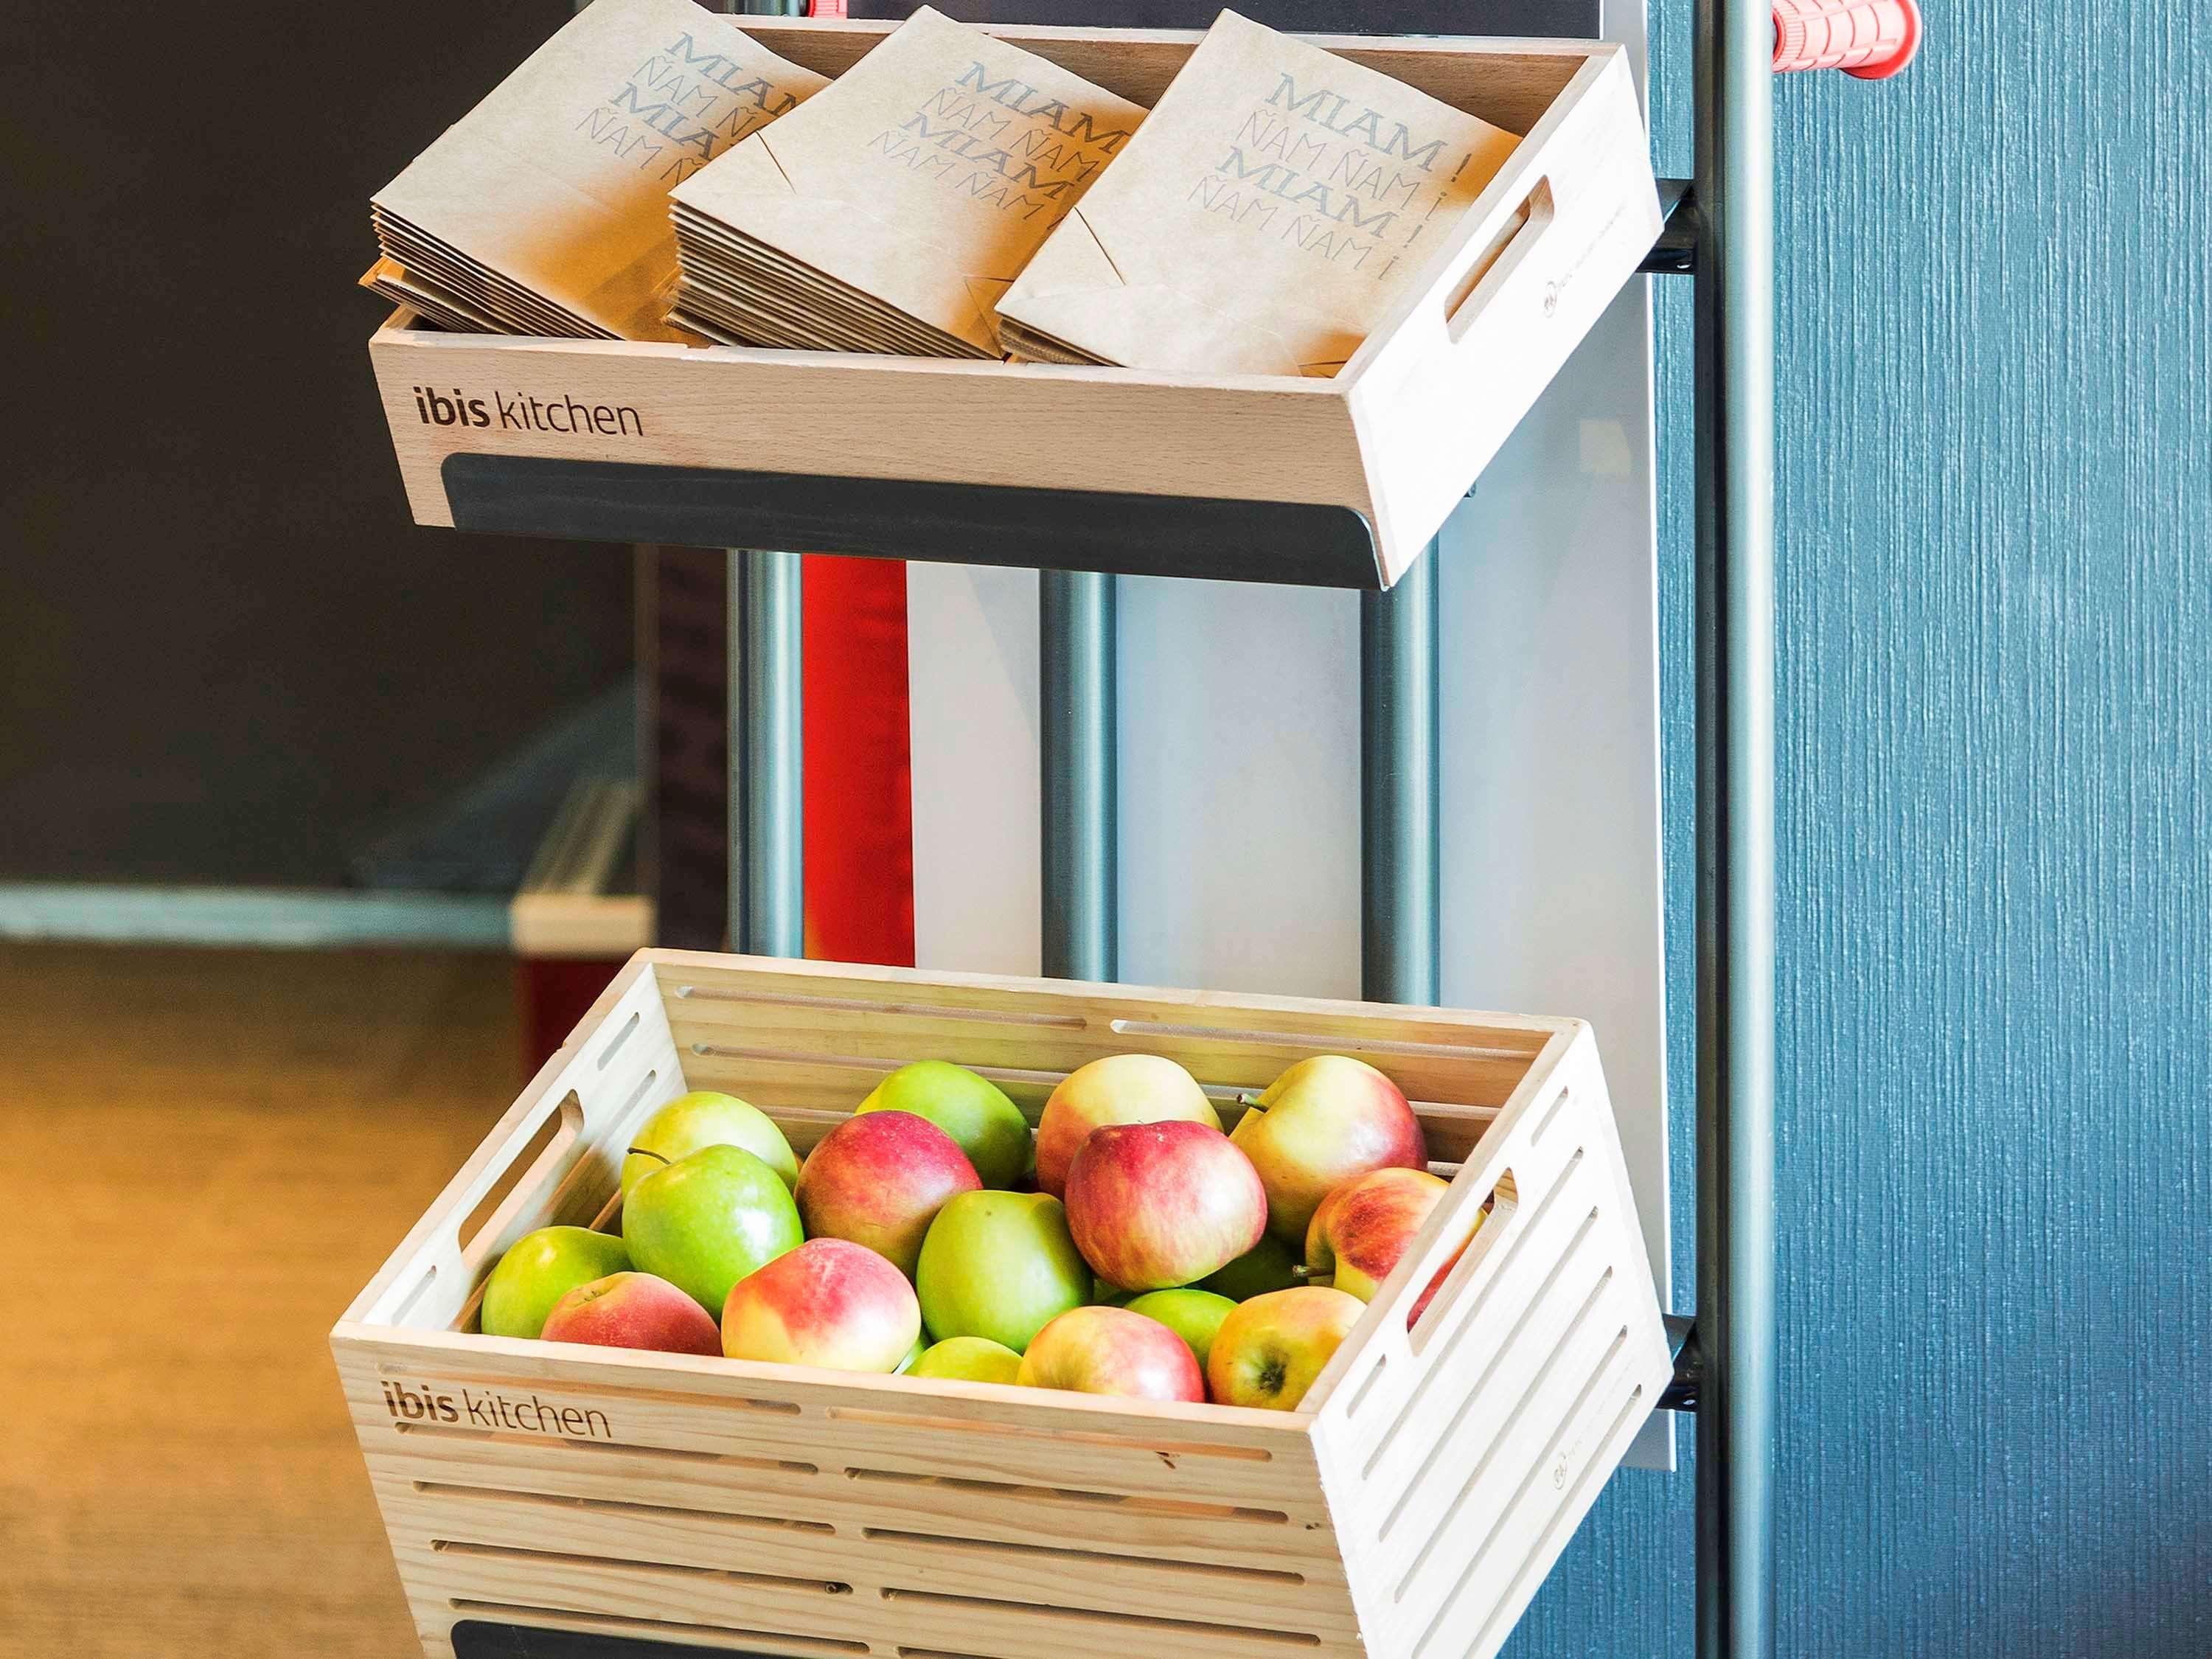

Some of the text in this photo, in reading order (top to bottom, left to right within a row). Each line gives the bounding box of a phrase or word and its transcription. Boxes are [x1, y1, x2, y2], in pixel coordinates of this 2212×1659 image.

[609, 82, 739, 161] MIA
[632, 55, 719, 118] ÑAM
[954, 61, 1131, 153] MIAM
[1264, 72, 1448, 172] MIAM
[575, 107, 663, 170] ÑAM
[867, 130, 1044, 220] ÑAM ÑAM
[898, 111, 1074, 200] MIAM
[922, 87, 1099, 181] ÑAM ÑAM
[1236, 109, 1327, 171] ÑAM
[1328, 149, 1420, 210] ÑAM
[1187, 174, 1278, 230] ÑAM
[1281, 215, 1372, 270] ÑAM
[1214, 146, 1399, 238] MIAM
[413, 386, 644, 436] ibis kitchen
[380, 1380, 611, 1438] ibis kitchen
